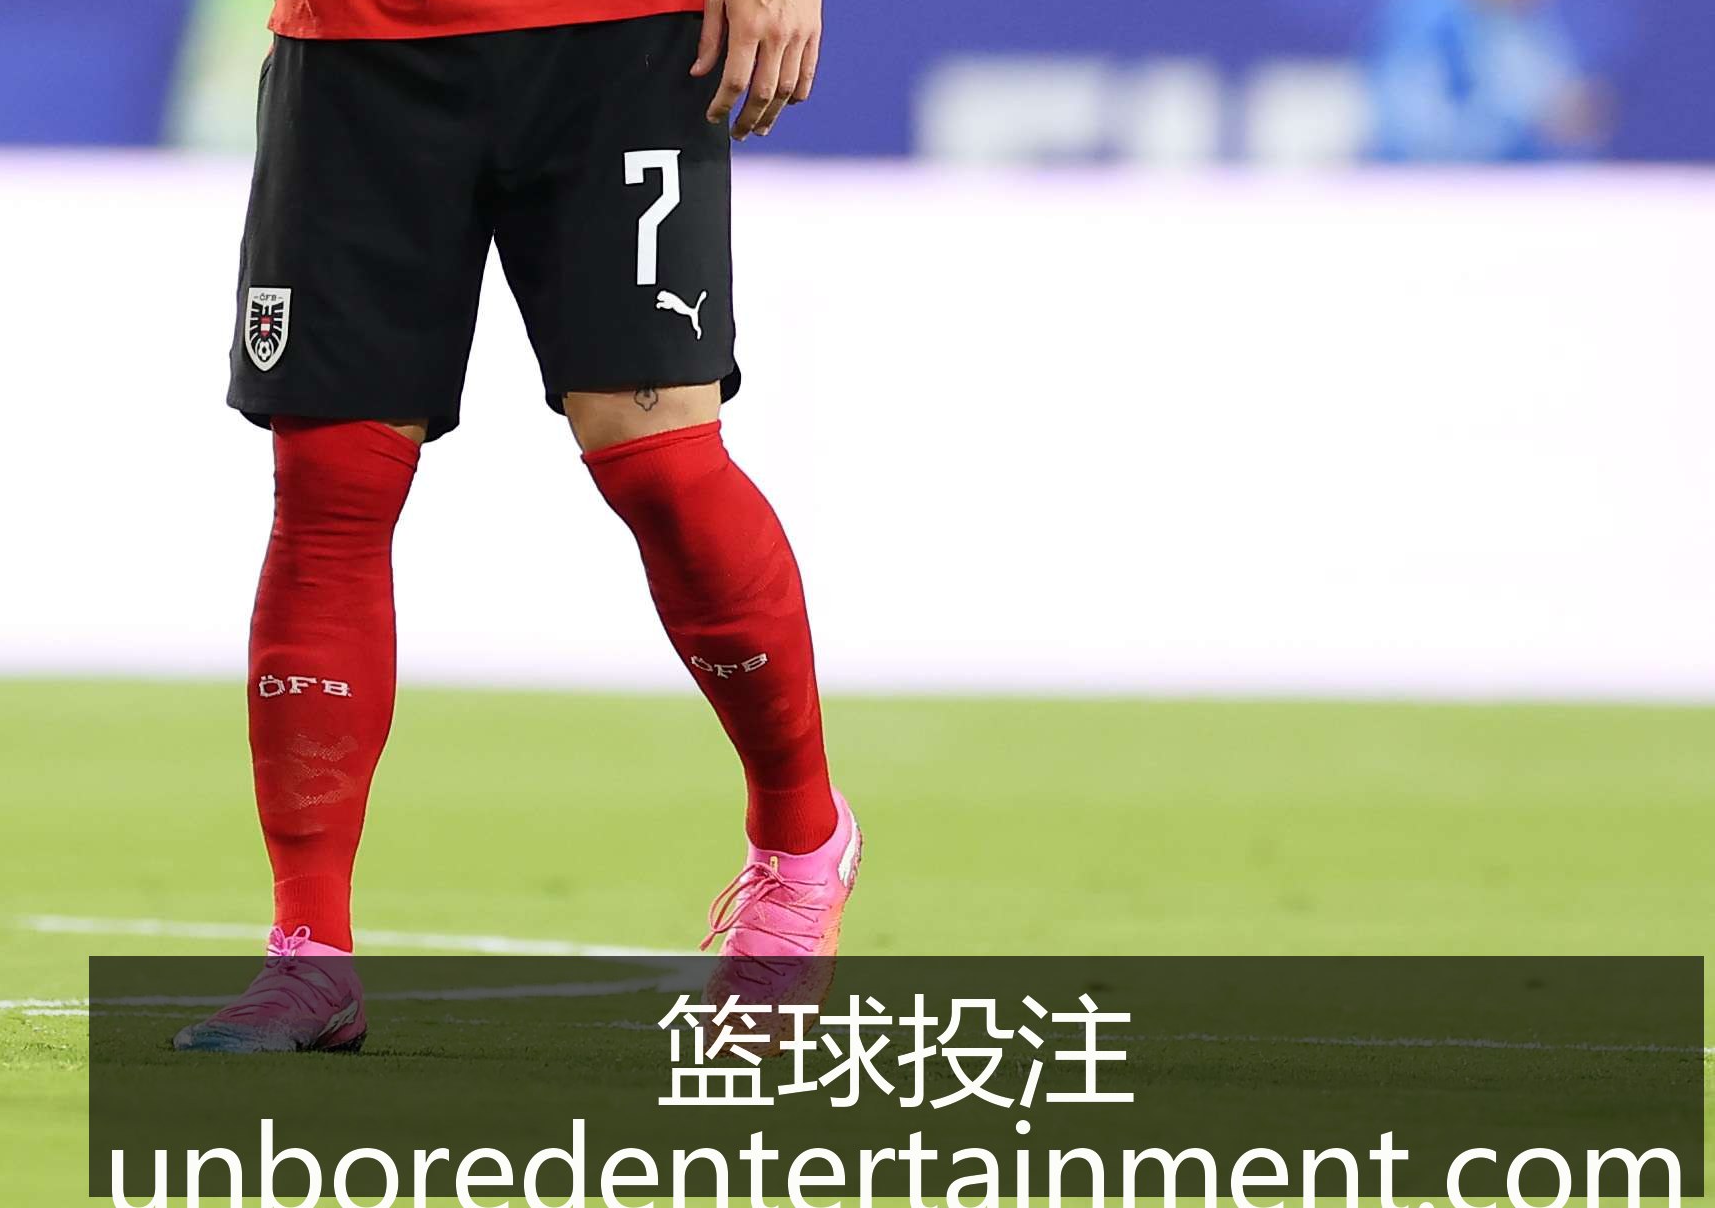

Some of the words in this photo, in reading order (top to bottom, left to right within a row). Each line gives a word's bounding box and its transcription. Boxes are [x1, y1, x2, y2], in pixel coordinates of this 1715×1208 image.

[624, 149, 681, 285] 7
[691, 653, 768, 679] ÖFB
[259, 675, 351, 697] ÖFB
